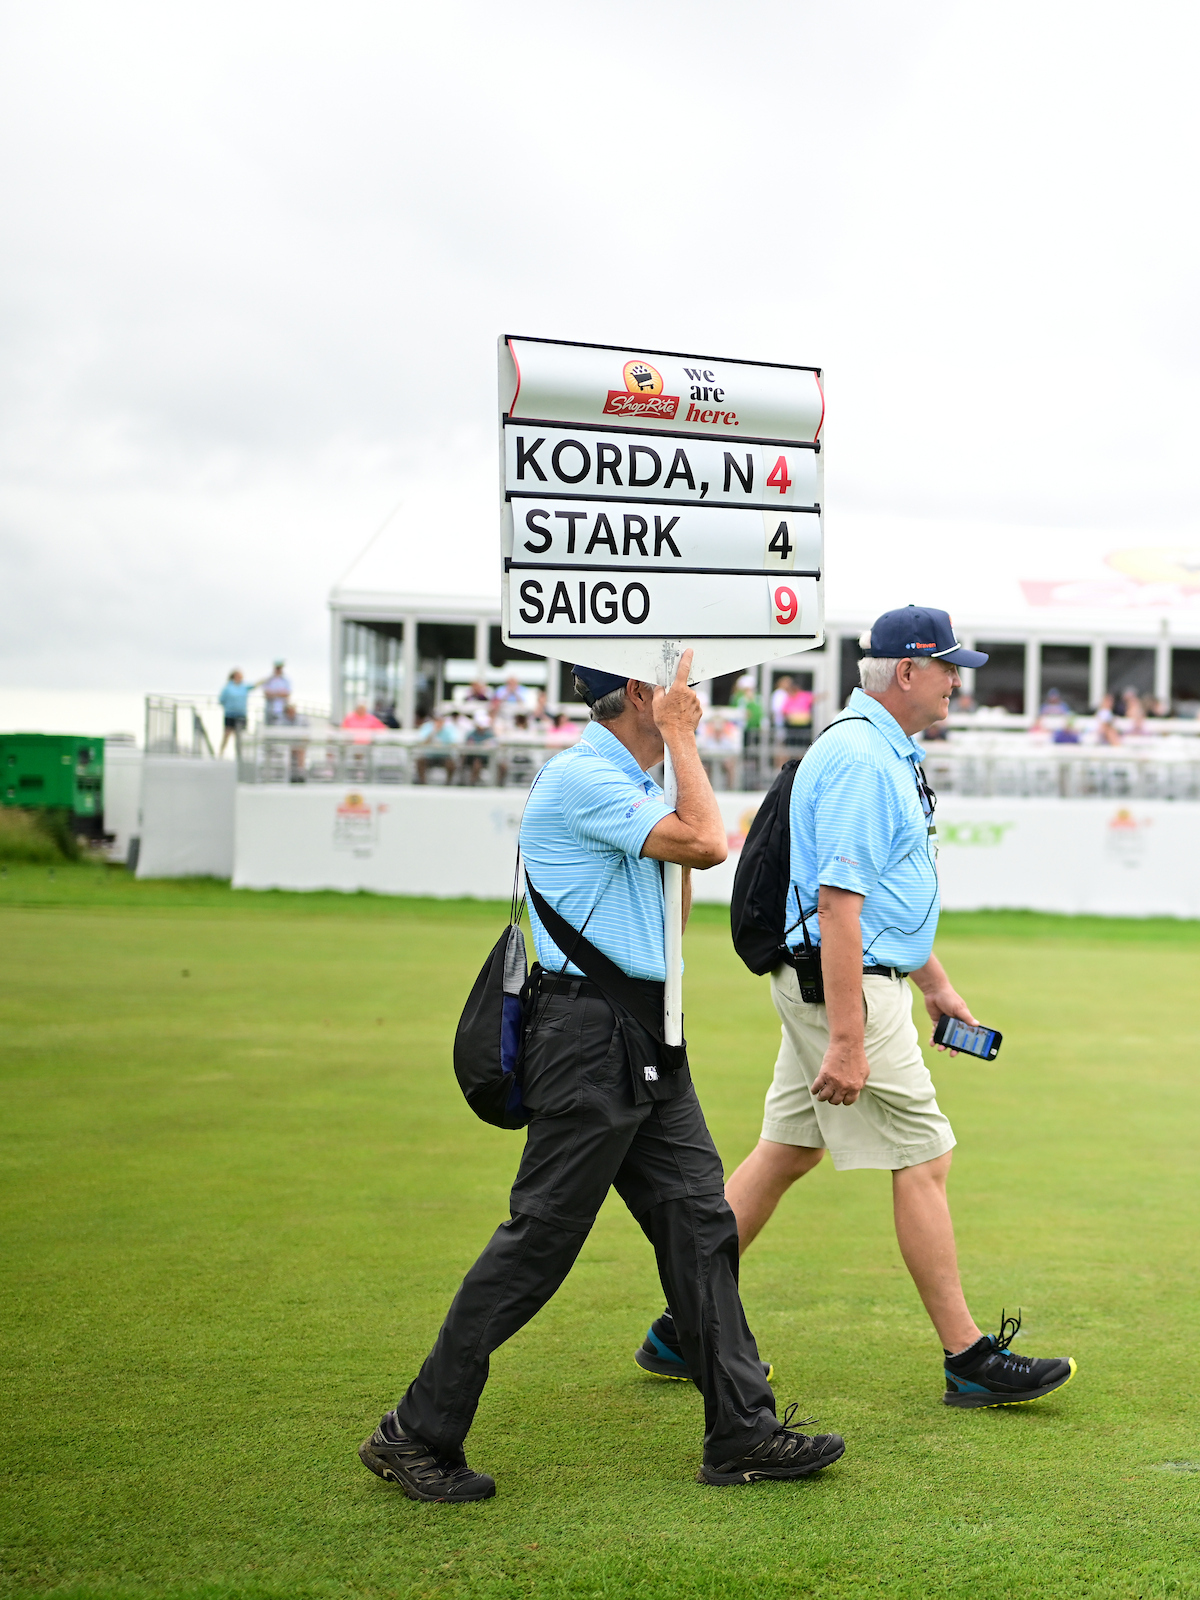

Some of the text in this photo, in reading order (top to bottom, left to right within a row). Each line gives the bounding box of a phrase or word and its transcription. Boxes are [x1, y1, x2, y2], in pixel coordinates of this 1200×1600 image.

[683, 367, 716, 383] we
[606, 395, 675, 417] ShopRite
[690, 385, 725, 403] are
[685, 402, 740, 426] here.
[516, 436, 793, 500] KORDA, N 4
[523, 508, 793, 560] STARK 4
[519, 579, 799, 626] SAIGO 9
